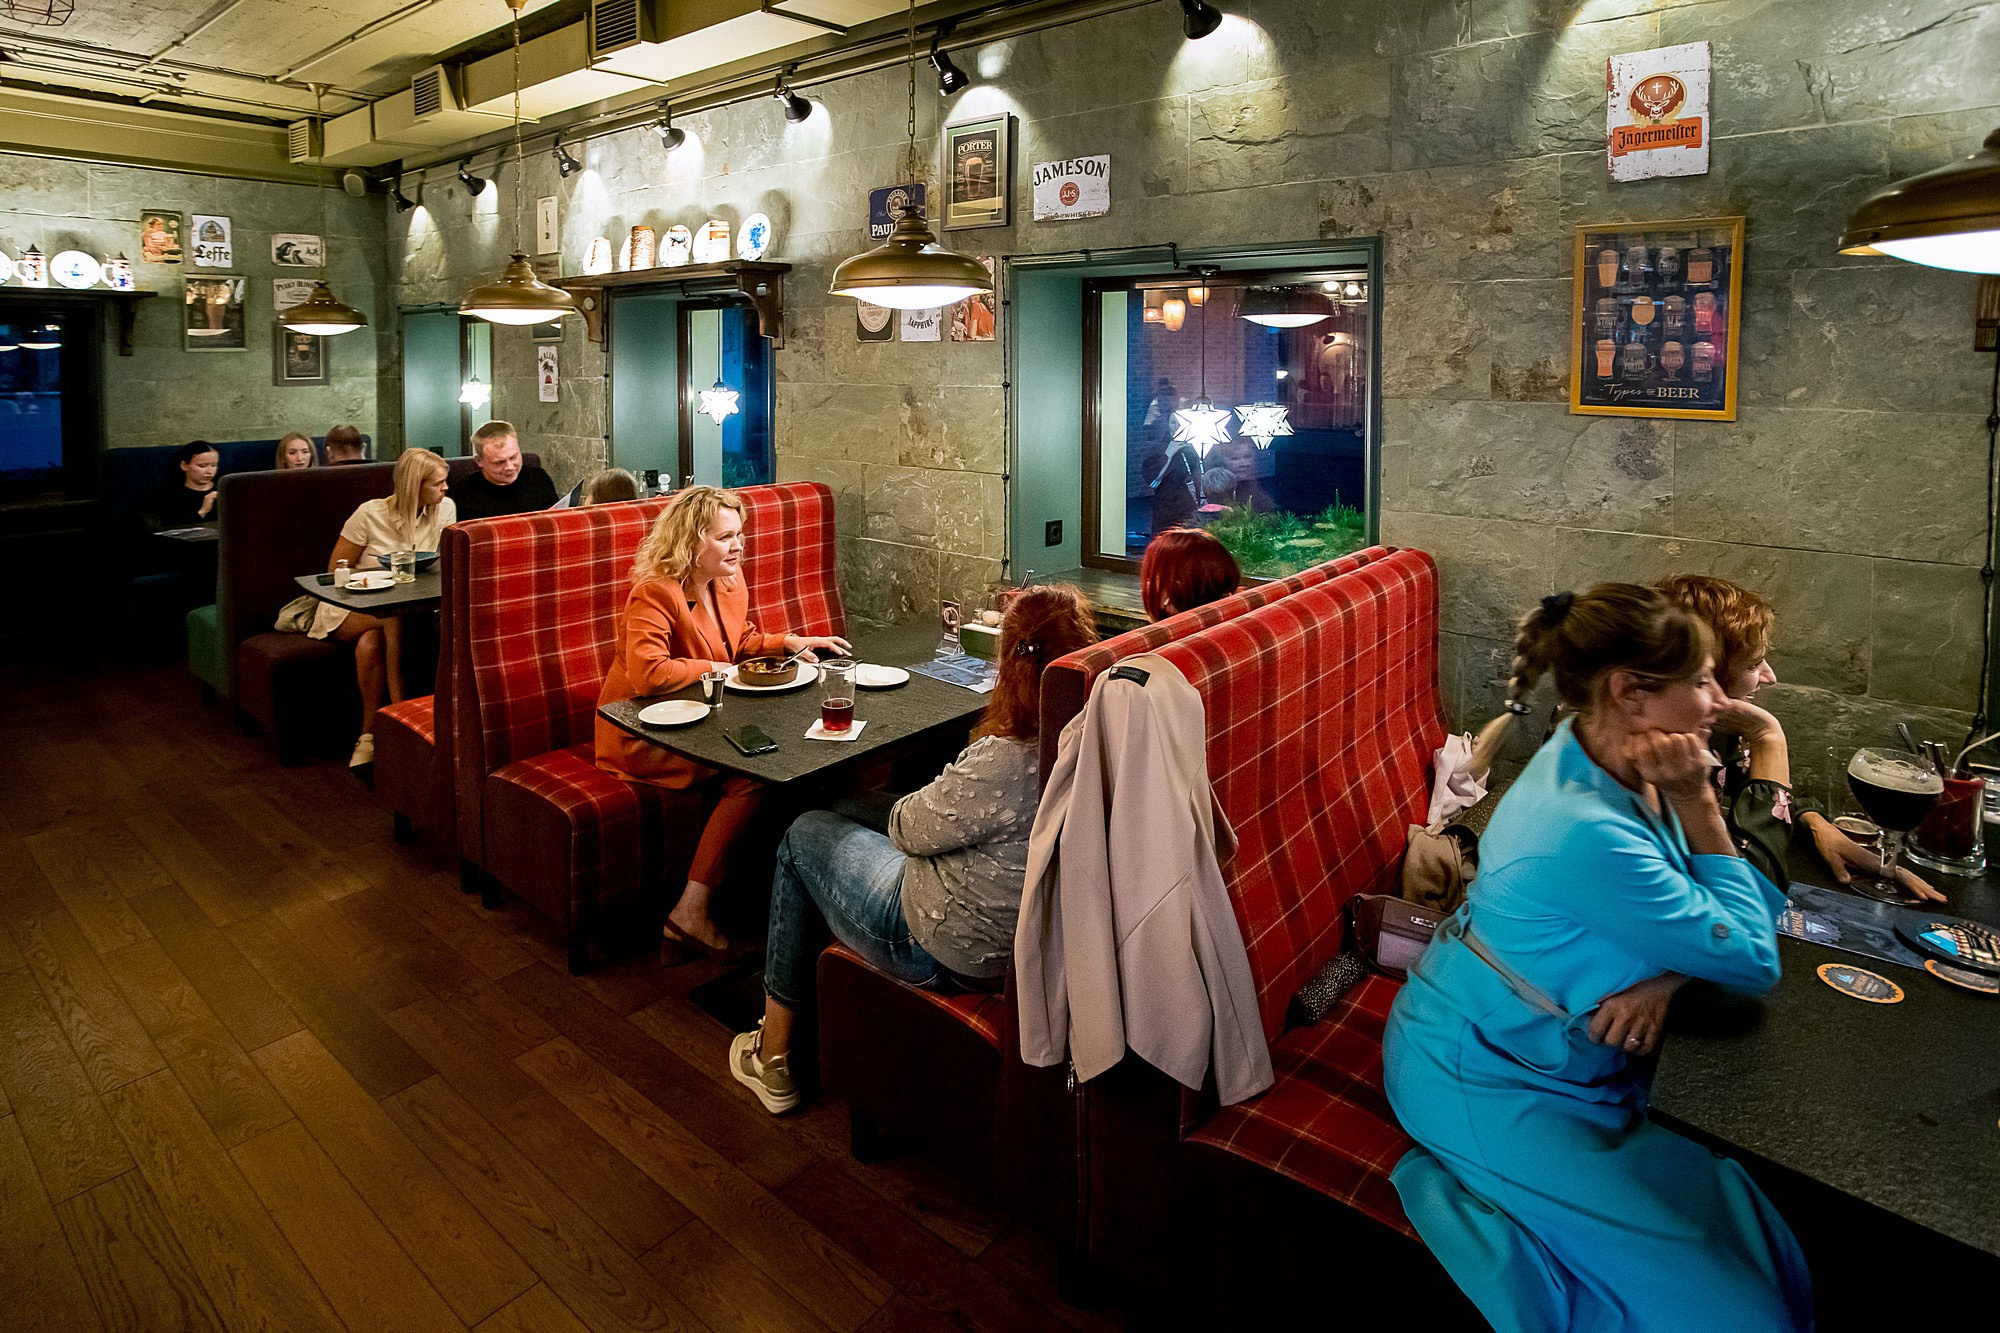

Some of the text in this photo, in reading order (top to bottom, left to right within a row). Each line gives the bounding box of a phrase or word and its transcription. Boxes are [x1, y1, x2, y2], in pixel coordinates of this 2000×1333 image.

[1618, 124, 1697, 149] Jägermeister
[957, 141, 992, 154] PORTER
[1034, 160, 1106, 186] JAMESON
[871, 223, 895, 237] PAUL
[195, 244, 231, 262] Leffe
[1604, 383, 1643, 401] Types
[1657, 387, 1699, 398] BEER
